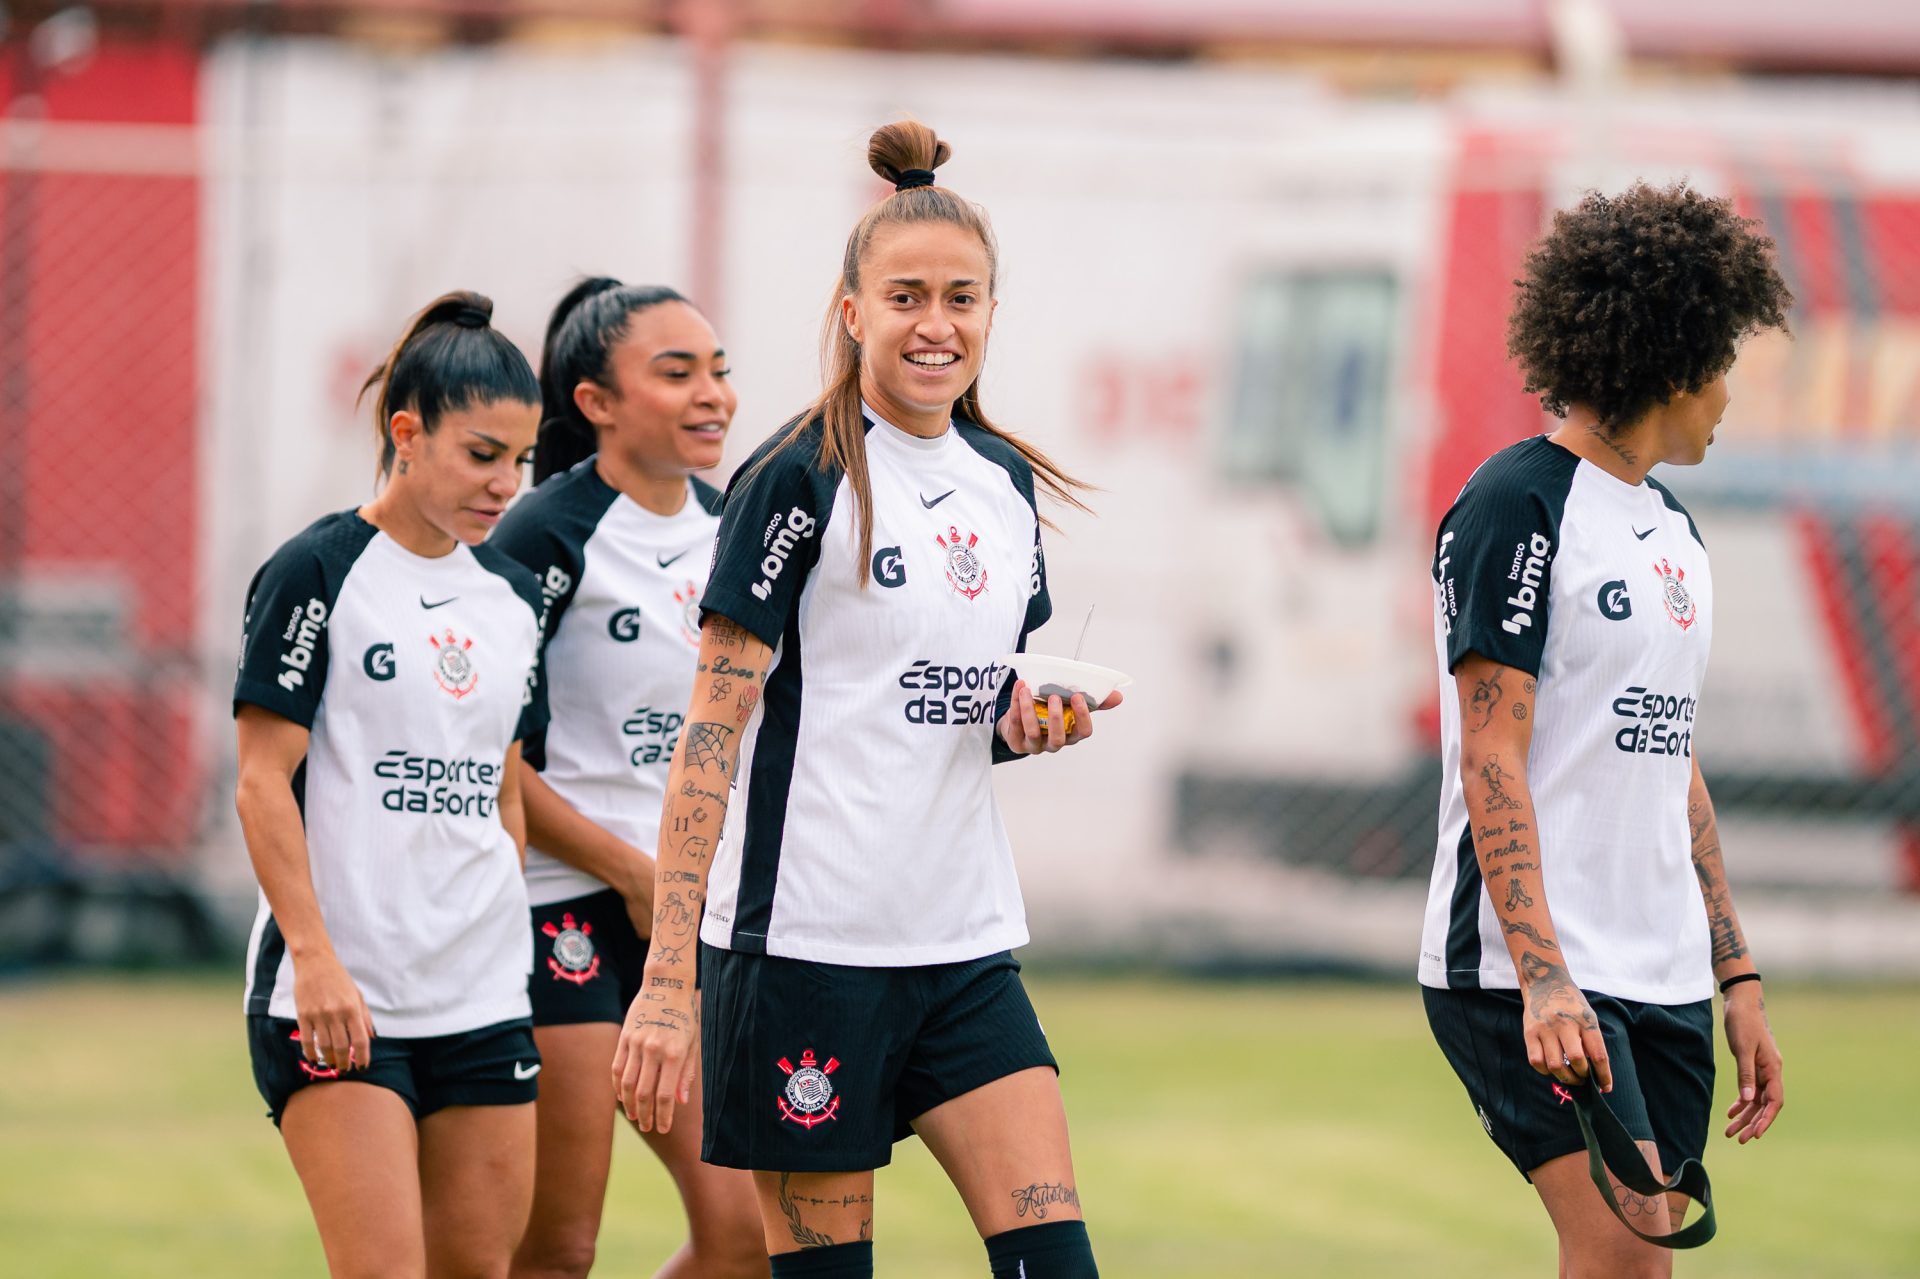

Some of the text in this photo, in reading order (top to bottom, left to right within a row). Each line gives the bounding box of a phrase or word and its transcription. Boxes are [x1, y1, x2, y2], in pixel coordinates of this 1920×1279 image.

[761, 506, 816, 580] bmg
[1508, 542, 1525, 580] banco
[872, 545, 907, 588] G
[1447, 577, 1457, 616] banco
[1597, 579, 1632, 621] G
[282, 605, 303, 641] banco
[608, 606, 640, 643] G
[363, 642, 396, 681] G
[899, 660, 1007, 698] Esport
[904, 694, 996, 725] da Sort
[1649, 724, 1691, 758] Sort
[382, 785, 494, 818] da Sort
[674, 815, 689, 832] 11
[651, 976, 684, 990] DEUS
